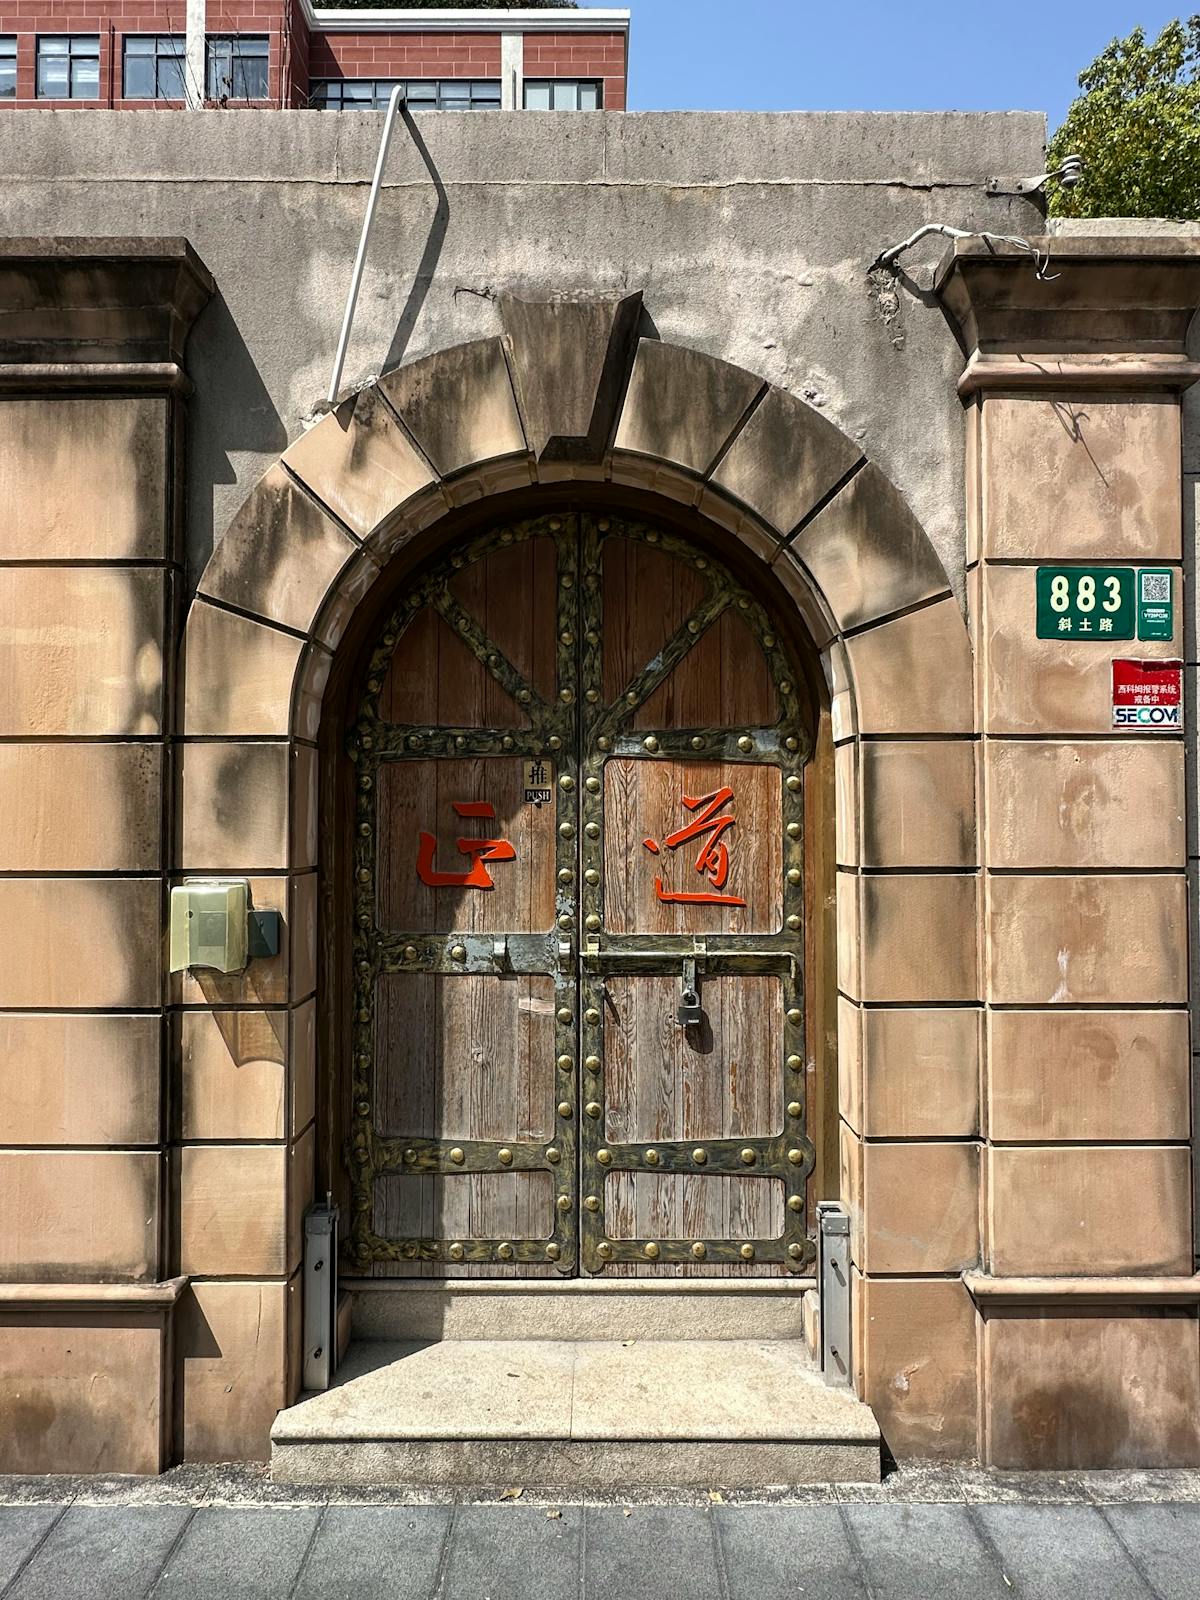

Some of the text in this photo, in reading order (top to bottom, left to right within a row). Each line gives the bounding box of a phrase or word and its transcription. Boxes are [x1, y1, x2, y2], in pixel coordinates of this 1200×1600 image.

[1050, 575, 1121, 612] 883
[1058, 617, 1113, 632] 斜土路
[1116, 708, 1178, 723] SECOM
[529, 766, 547, 784] 推
[526, 791, 549, 800] PUSH
